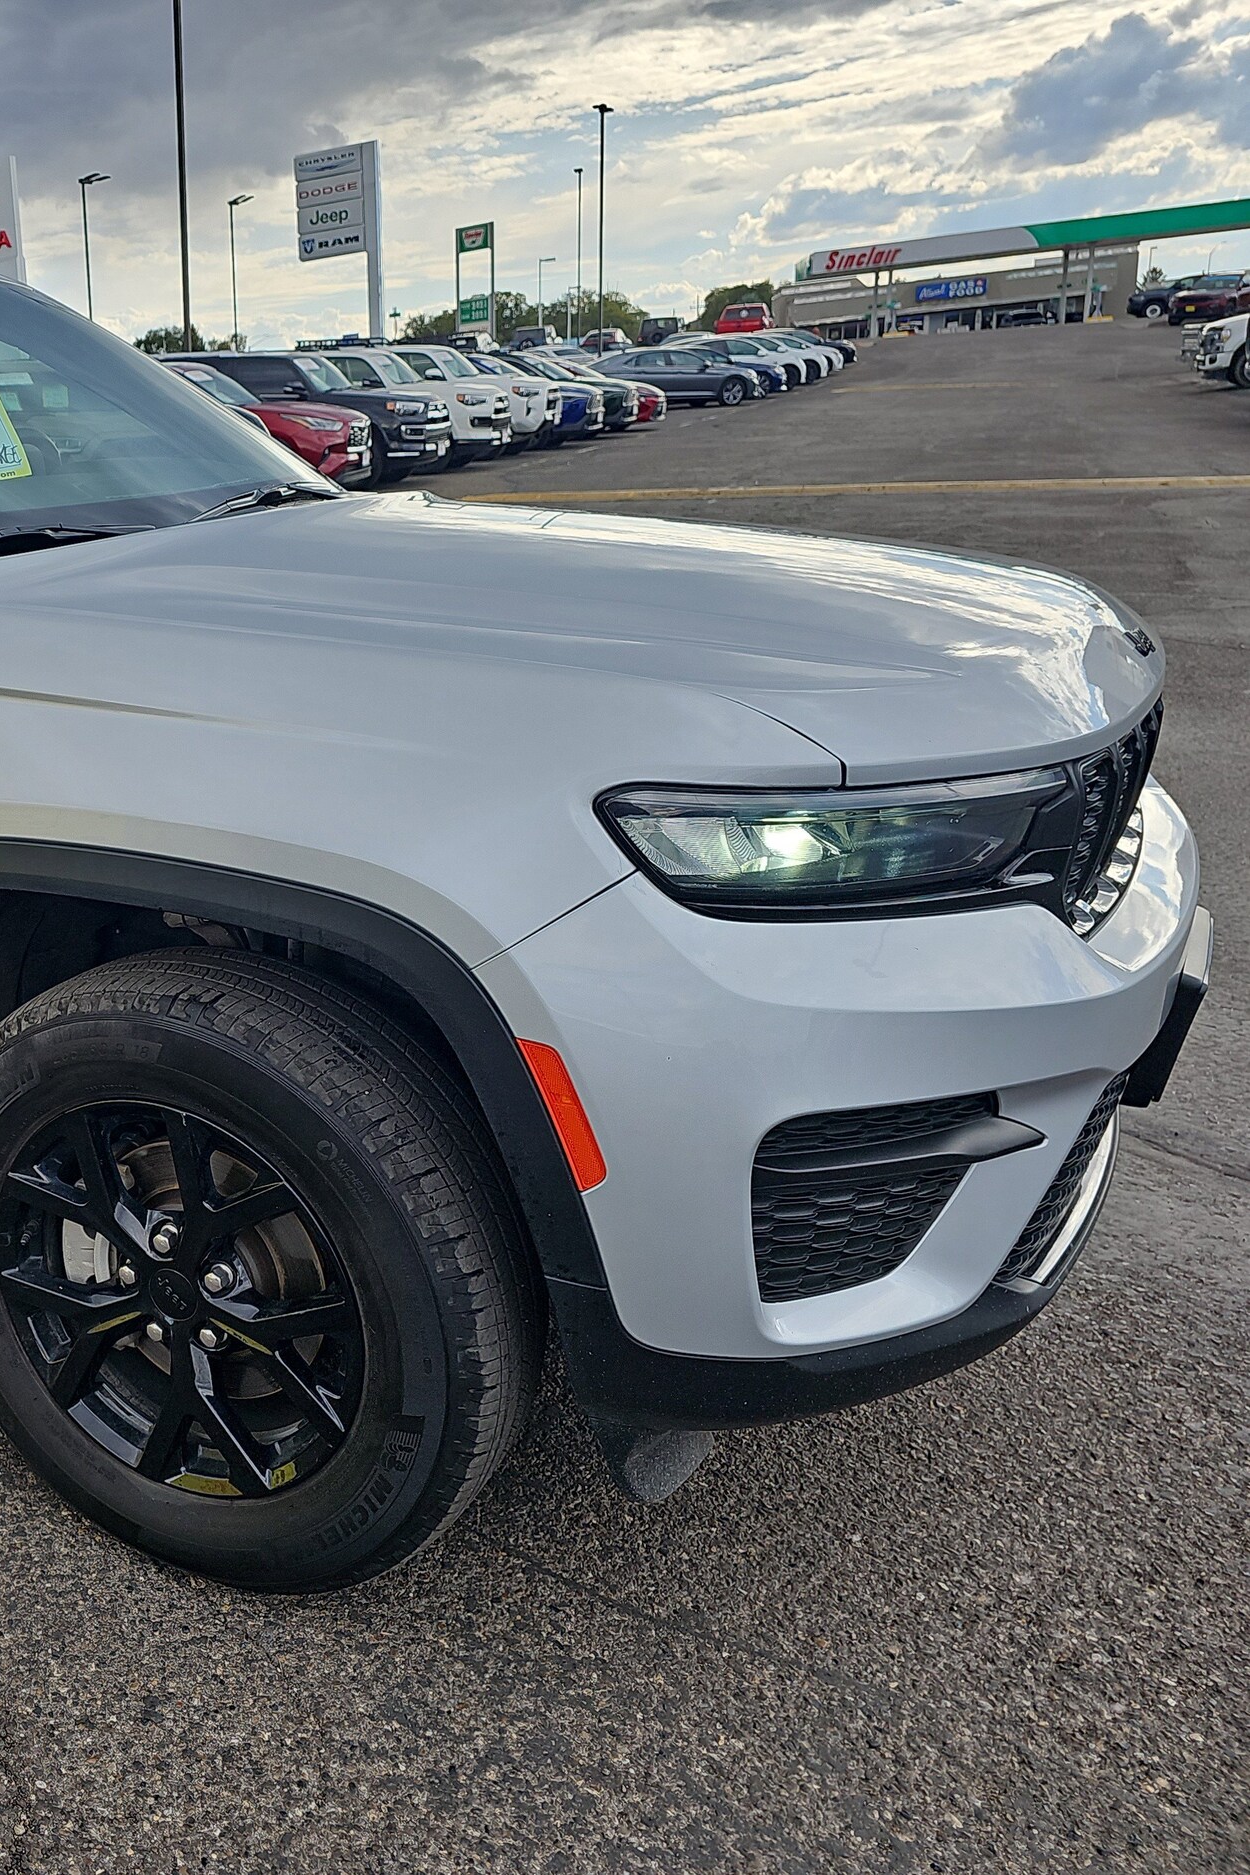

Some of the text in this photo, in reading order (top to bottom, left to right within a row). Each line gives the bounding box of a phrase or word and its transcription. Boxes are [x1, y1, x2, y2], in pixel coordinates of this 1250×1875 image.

[299, 182, 358, 200] DODGE
[310, 209, 349, 225] Jeep
[318, 235, 360, 249] RAM
[825, 247, 902, 271] Sinclair
